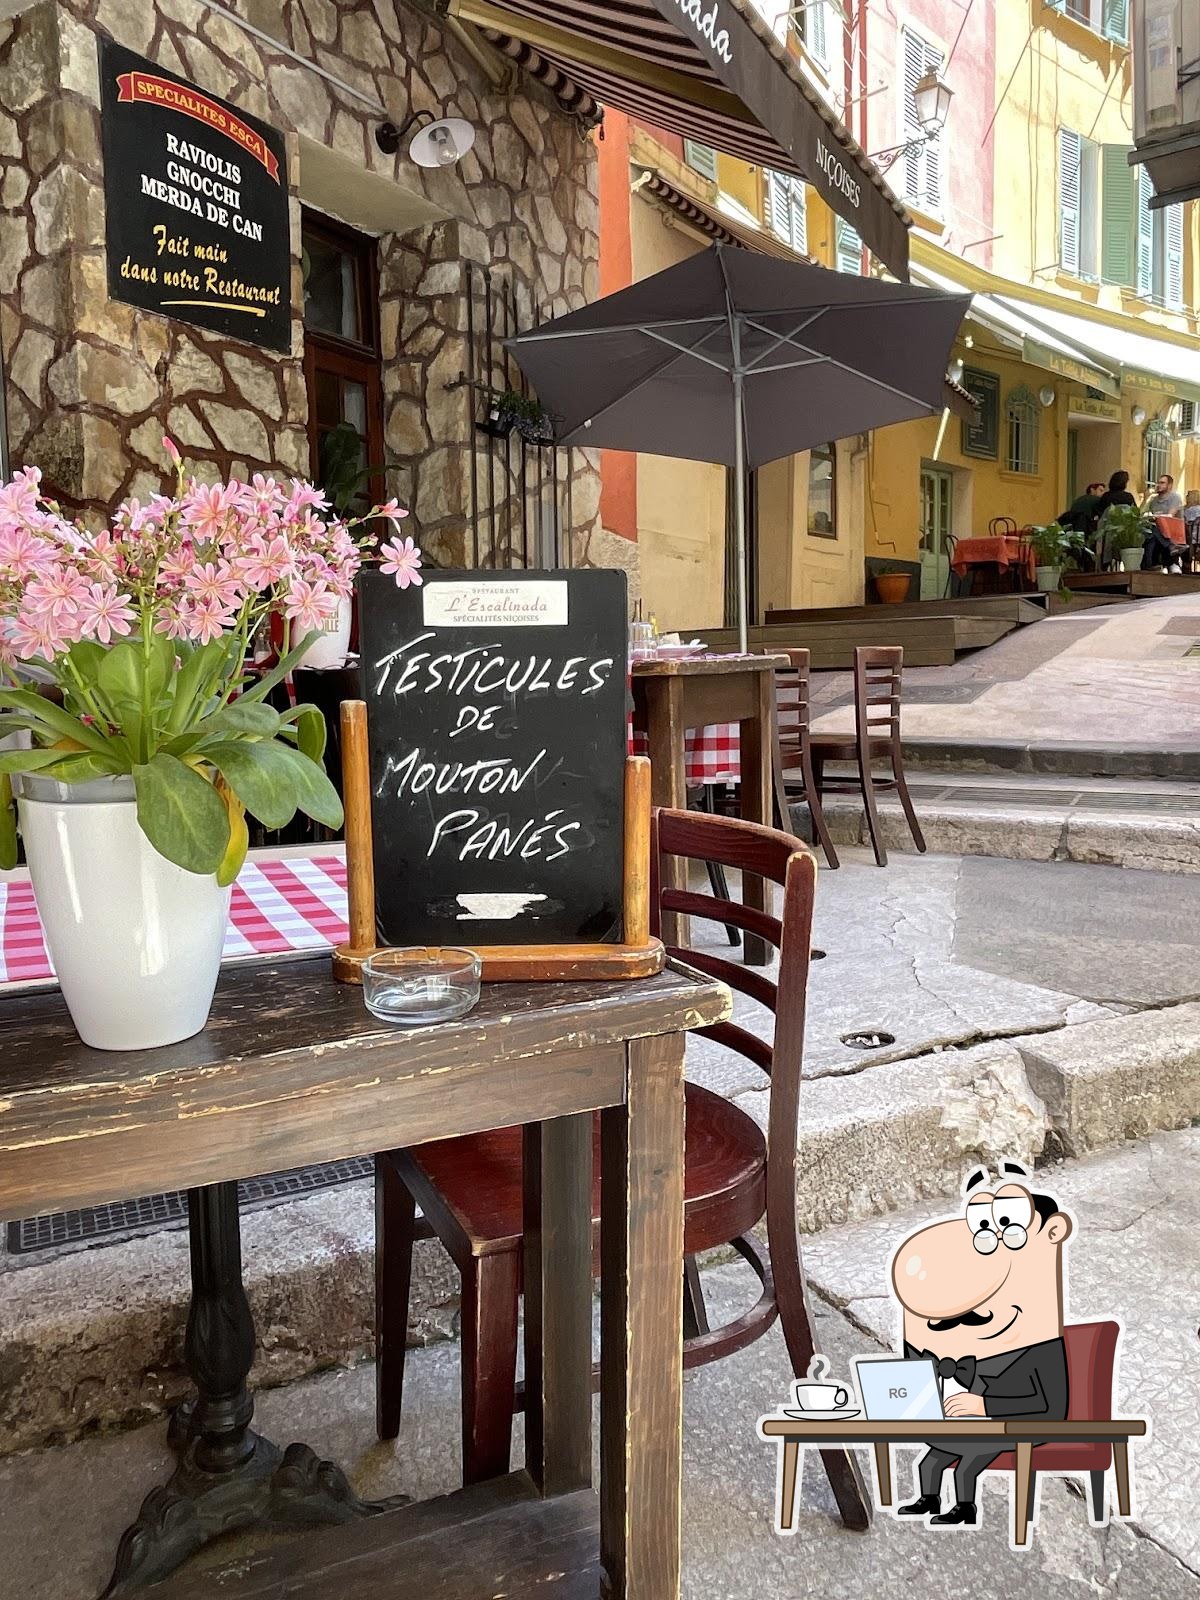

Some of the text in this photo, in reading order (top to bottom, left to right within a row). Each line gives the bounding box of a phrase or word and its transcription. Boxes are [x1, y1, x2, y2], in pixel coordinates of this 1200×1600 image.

[137, 80, 263, 155] SPECIALITES ESCA
[166, 132, 242, 185] RAVIOLIS
[815, 137, 862, 209] NIÇOISES
[140, 173, 263, 242] MERDA DE CAN
[166, 160, 241, 210] GNOCCHI
[152, 224, 229, 264] Fait main
[120, 255, 281, 305] dans notre Restaurant
[503, 614, 540, 624] NIÇOISES
[375, 632, 614, 696] TESTICULES
[449, 704, 502, 738] DE
[376, 747, 547, 798] MOUTON
[426, 808, 582, 862] PANÉS
